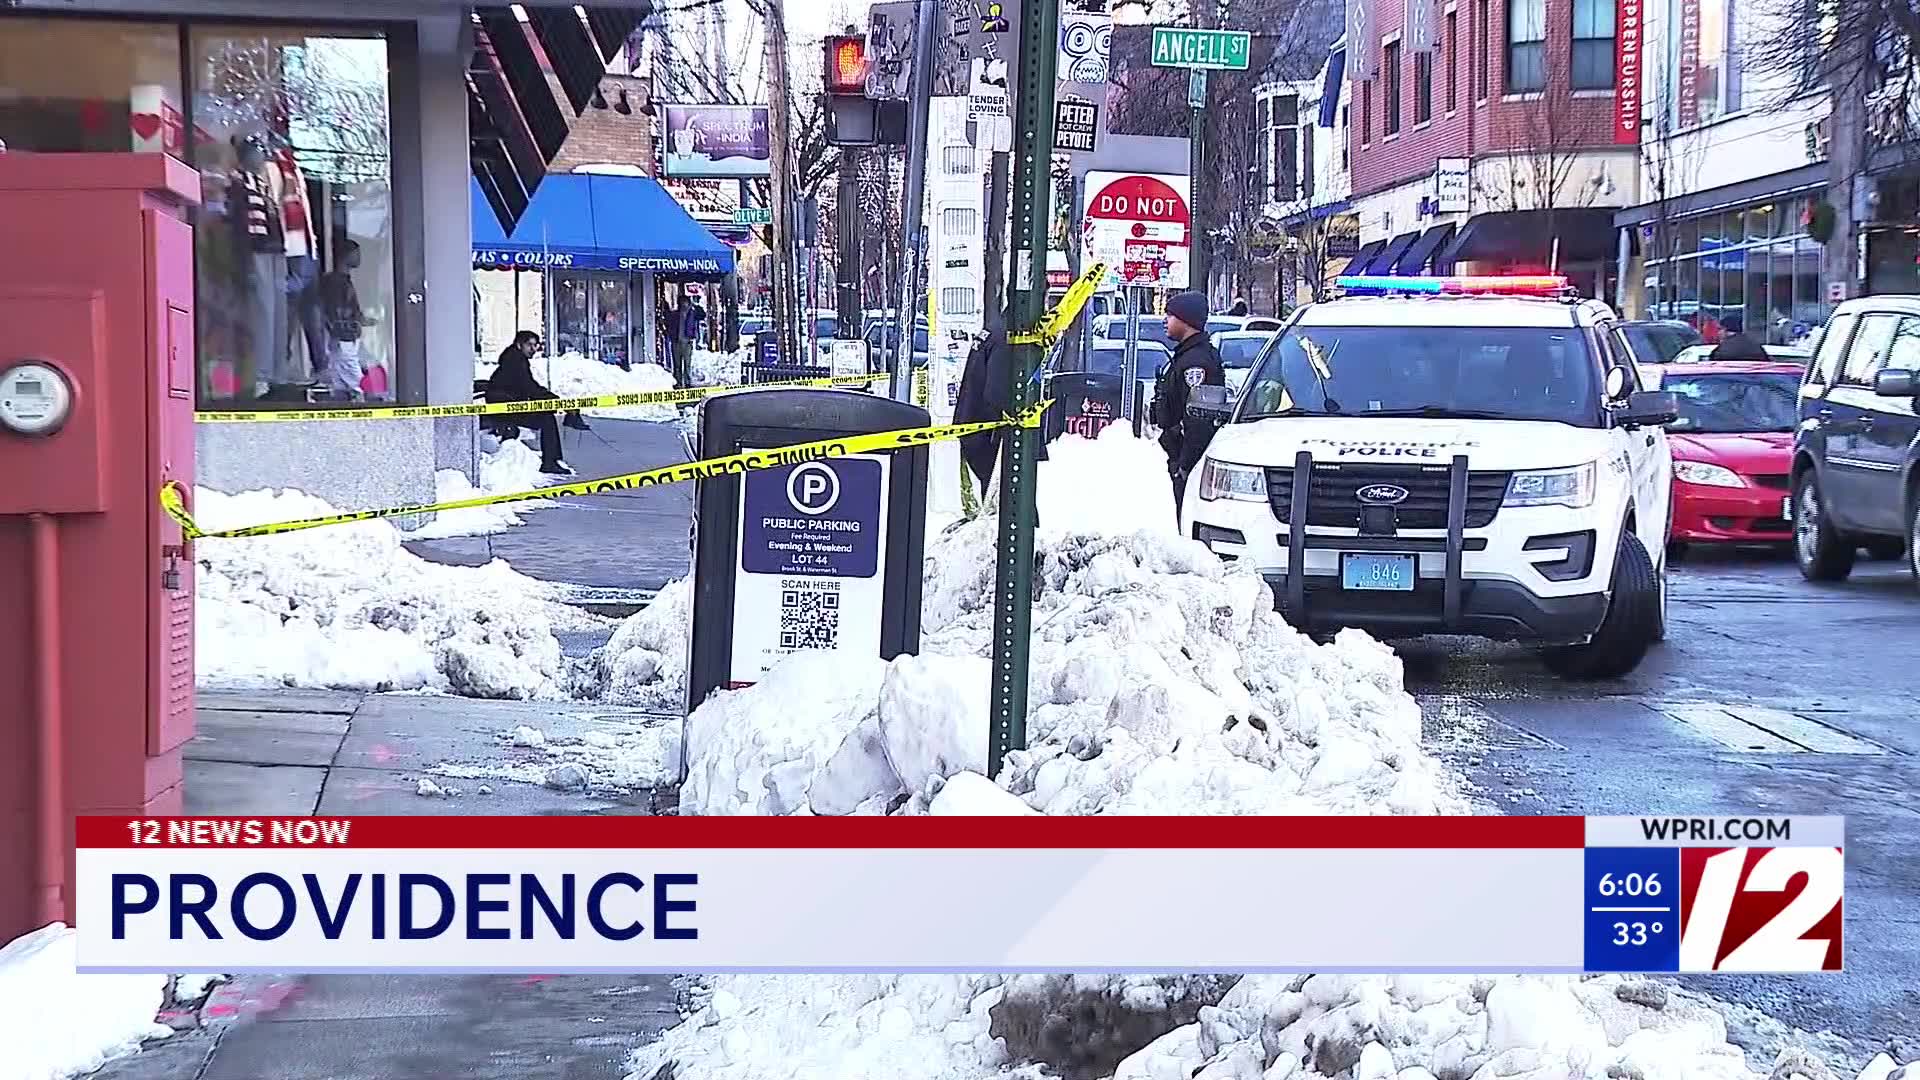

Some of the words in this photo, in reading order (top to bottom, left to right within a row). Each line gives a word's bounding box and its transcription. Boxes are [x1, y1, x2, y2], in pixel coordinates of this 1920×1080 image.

[1156, 33, 1230, 63] ANGELL
[1231, 36, 1246, 54] ST
[969, 95, 1005, 105] TENDER
[969, 105, 1004, 113] LOVING
[1059, 105, 1095, 125] PETER
[702, 121, 764, 131] SPECTRUM
[1056, 132, 1093, 149] PEYOTE
[1100, 195, 1128, 214] DO
[1136, 197, 1177, 217] NOT
[734, 210, 762, 221] OLIVE
[514, 252, 574, 266] COLORS
[619, 257, 720, 271] SPECTRUM-INDIA
[617, 394, 638, 405] CROSS
[639, 393, 652, 403] NOT
[653, 392, 662, 402] DO
[664, 391, 685, 401] SCENE
[686, 389, 707, 399] CRIME
[577, 397, 598, 408] CRIME
[767, 443, 846, 467] CRIME
[1338, 447, 1437, 457] POLICE
[803, 474, 827, 504] P
[762, 518, 806, 530] PUBLIC
[808, 520, 860, 532] PARKING
[803, 533, 831, 541] Required
[768, 541, 803, 552] Evening
[804, 542, 812, 551] &
[813, 543, 852, 553] Weekend
[791, 554, 814, 564] LOT
[815, 556, 828, 565] 44
[1371, 562, 1400, 581] 846
[781, 579, 810, 589] SCAN
[813, 580, 841, 590] HERE
